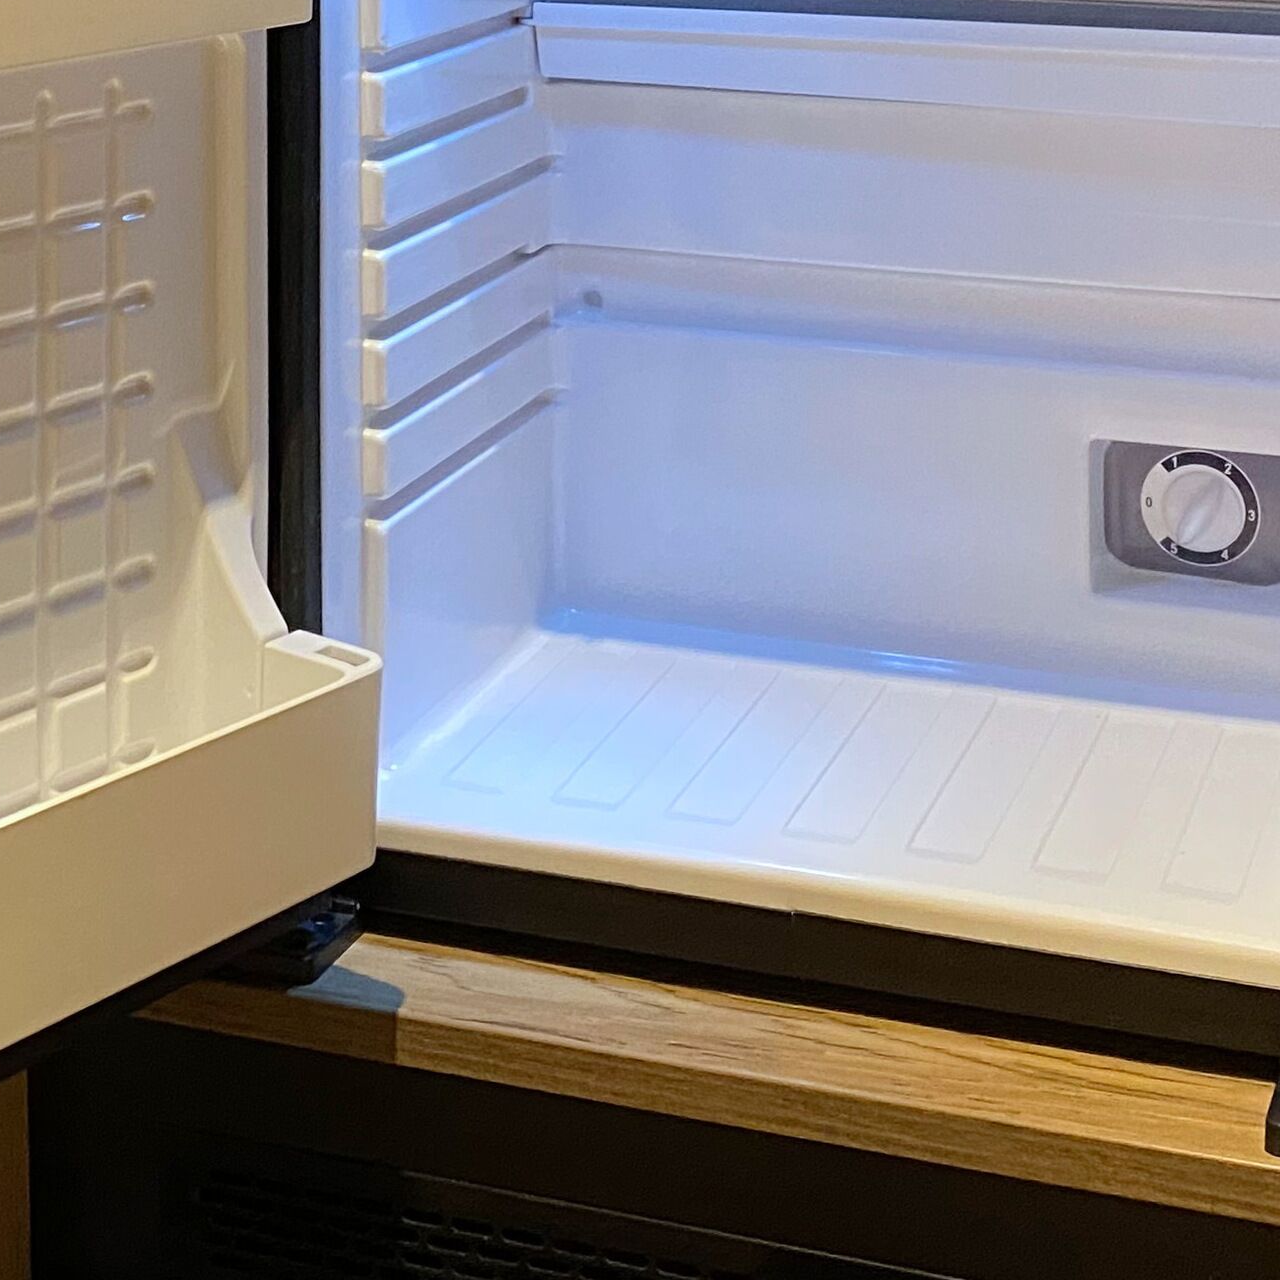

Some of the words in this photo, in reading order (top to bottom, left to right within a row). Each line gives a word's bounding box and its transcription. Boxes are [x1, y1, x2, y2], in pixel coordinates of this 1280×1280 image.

[1172, 457, 1178, 467] 1
[1224, 463, 1233, 475] 2
[1145, 497, 1152, 507] 0
[1248, 510, 1256, 521] 3
[1169, 543, 1178, 555] 5
[1220, 549, 1230, 561] 4
